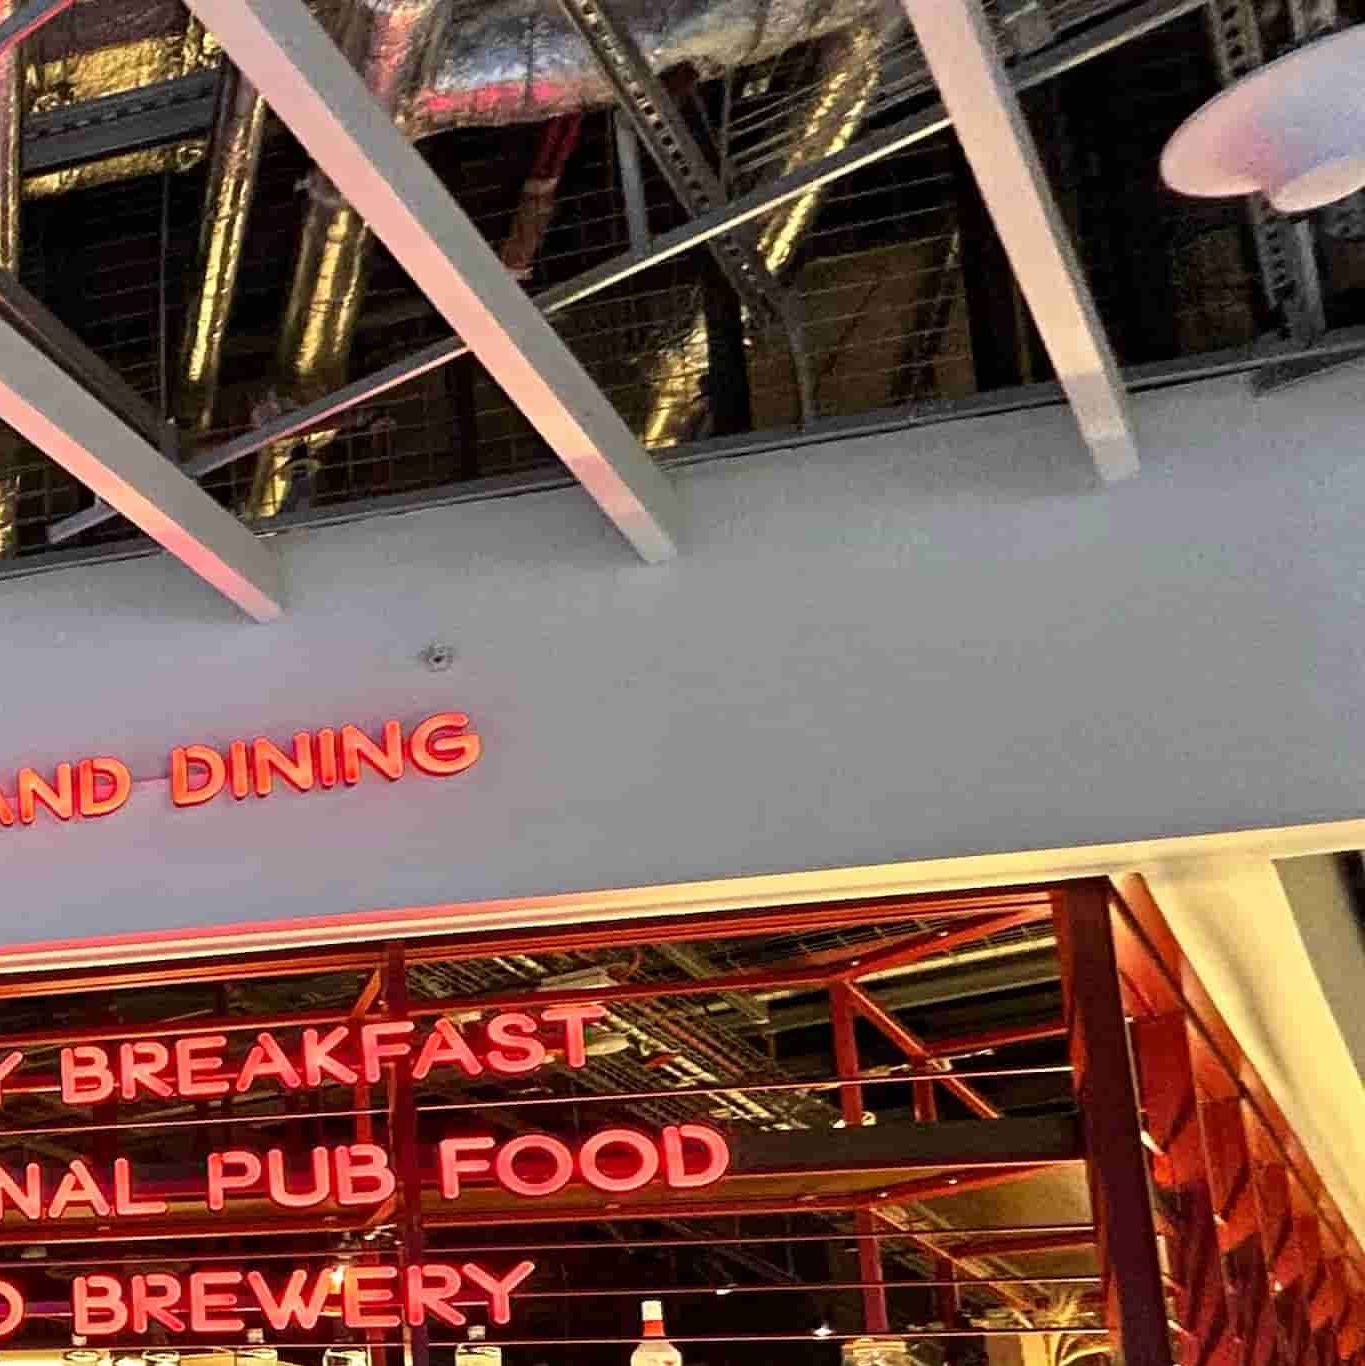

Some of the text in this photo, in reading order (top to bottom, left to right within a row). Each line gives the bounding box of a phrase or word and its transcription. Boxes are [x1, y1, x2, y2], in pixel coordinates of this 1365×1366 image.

[171, 711, 482, 808] DINING
[61, 1002, 606, 1107] BREAKFAST
[206, 1141, 397, 1211] PUB
[436, 1123, 732, 1202] FOOD
[72, 1257, 536, 1337] BREWERY
